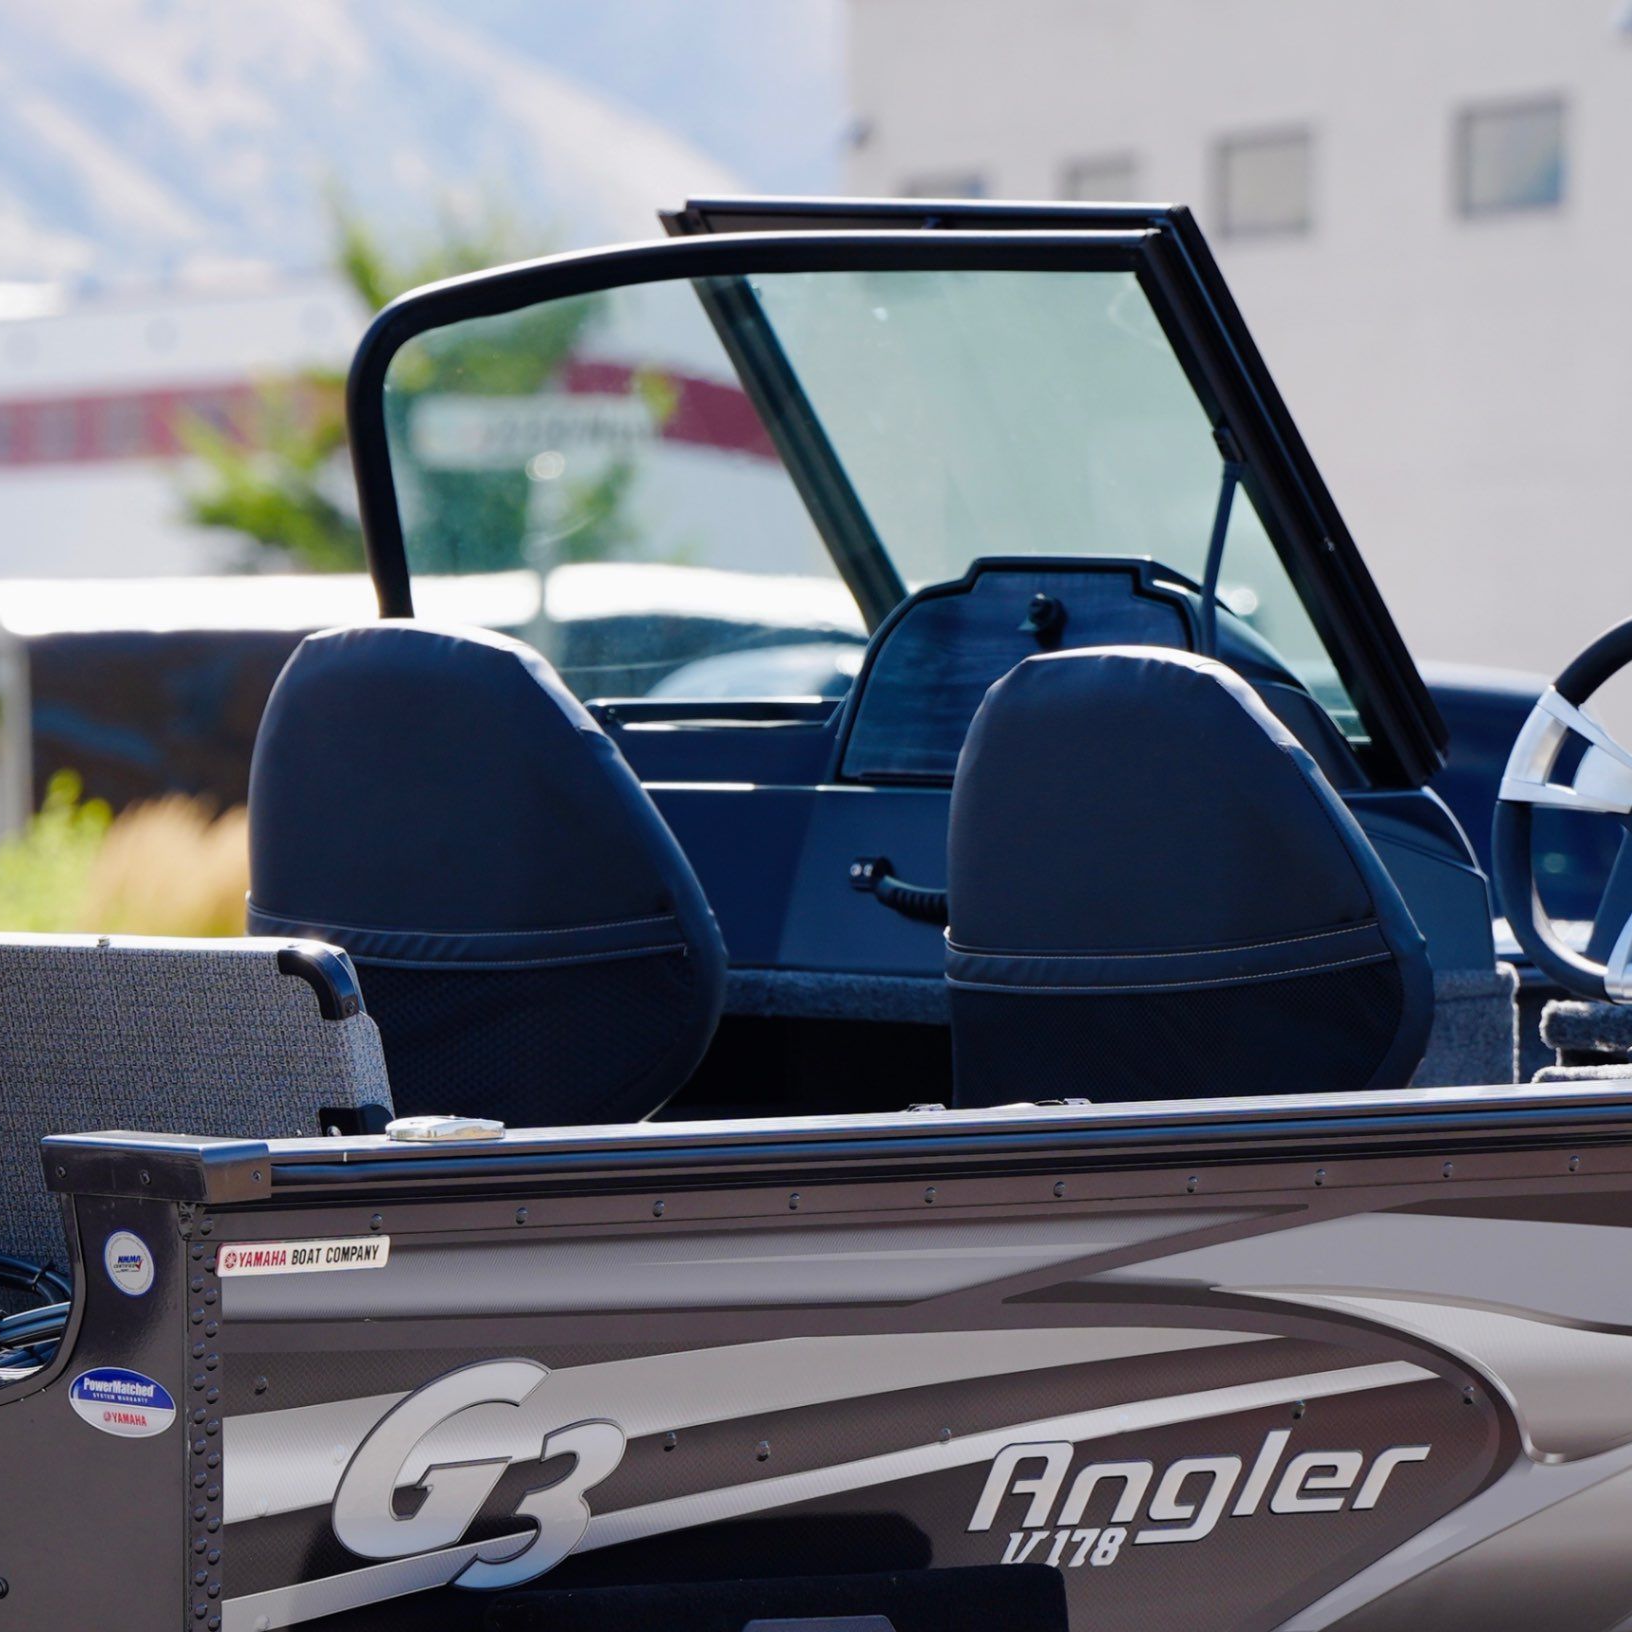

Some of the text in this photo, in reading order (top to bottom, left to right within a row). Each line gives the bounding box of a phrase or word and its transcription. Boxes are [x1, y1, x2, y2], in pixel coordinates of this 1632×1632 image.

[238, 1244, 380, 1268] YAMAHA BOAT COMPANY
[83, 1377, 154, 1398] PowerMatched
[112, 1412, 148, 1426] YAMAHA
[331, 1356, 627, 1591] G3
[965, 1427, 1432, 1545] Angler
